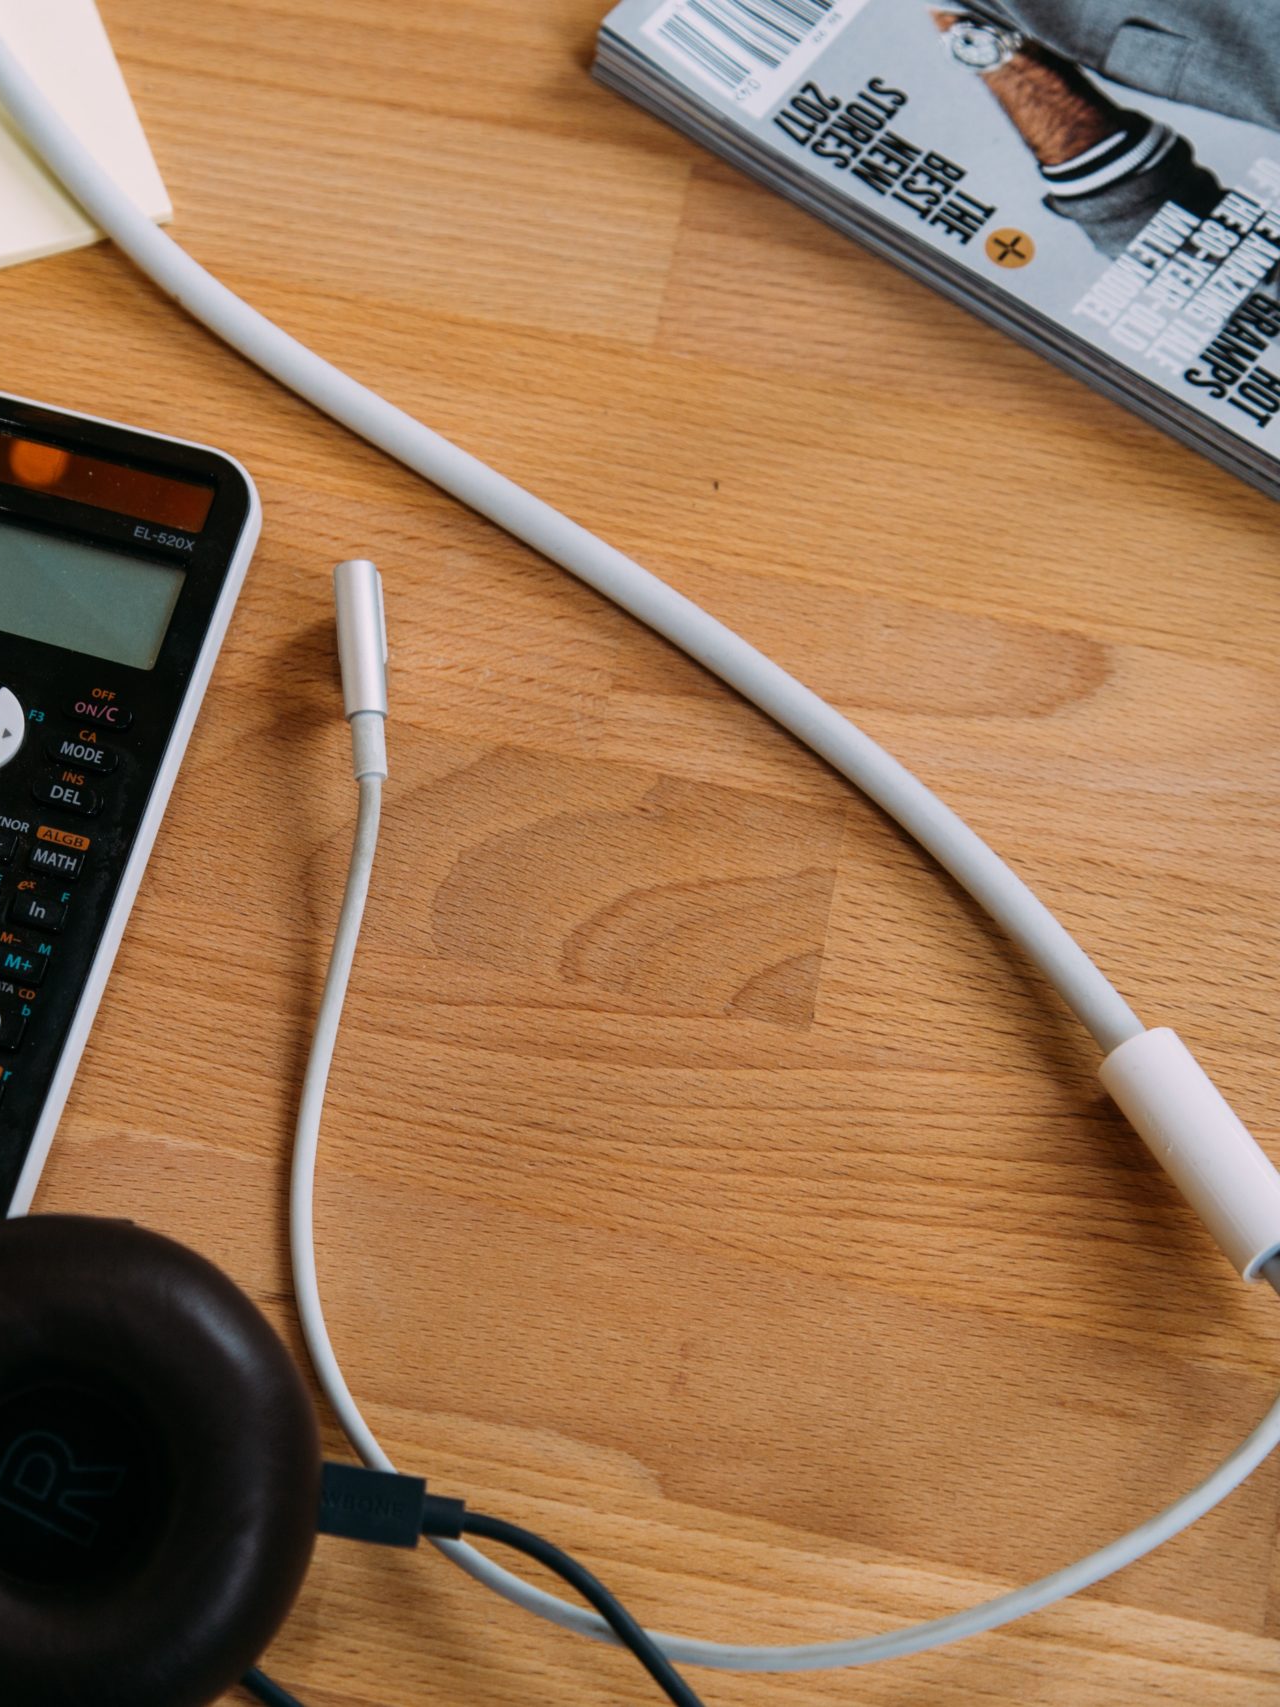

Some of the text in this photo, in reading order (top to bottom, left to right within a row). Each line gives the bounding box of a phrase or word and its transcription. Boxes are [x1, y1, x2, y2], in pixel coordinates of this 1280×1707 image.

[771, 80, 843, 148] 2017
[809, 76, 910, 171] STORES
[850, 129, 924, 197] NEW
[890, 149, 968, 221] BEST
[928, 189, 998, 246] THE
[1210, 185, 1269, 234] THE
[1071, 200, 1202, 328] MALE MODEL
[1108, 219, 1241, 351] 80-YEAR-OLD
[1182, 231, 1280, 324] AMAZING
[1144, 314, 1220, 376] TALE
[1184, 292, 1280, 399] GRAMPS
[1227, 366, 1280, 428] HOT
[133, 524, 196, 553] EL-520X
[92, 688, 117, 702] OFF
[28, 709, 46, 723] F3
[74, 701, 120, 722] ON/C
[79, 729, 98, 744] CA
[60, 741, 105, 765] MODE
[62, 770, 86, 786] INS
[49, 784, 83, 806] DEL
[43, 828, 85, 849] ALGB
[33, 847, 78, 872] MATH
[28, 900, 47, 920] ln
[61, 892, 71, 904] F
[37, 942, 53, 957] M
[3, 953, 33, 972] M+
[17, 987, 37, 1002] CD
[21, 1004, 32, 1017] b
[2, 1069, 13, 1082] r
